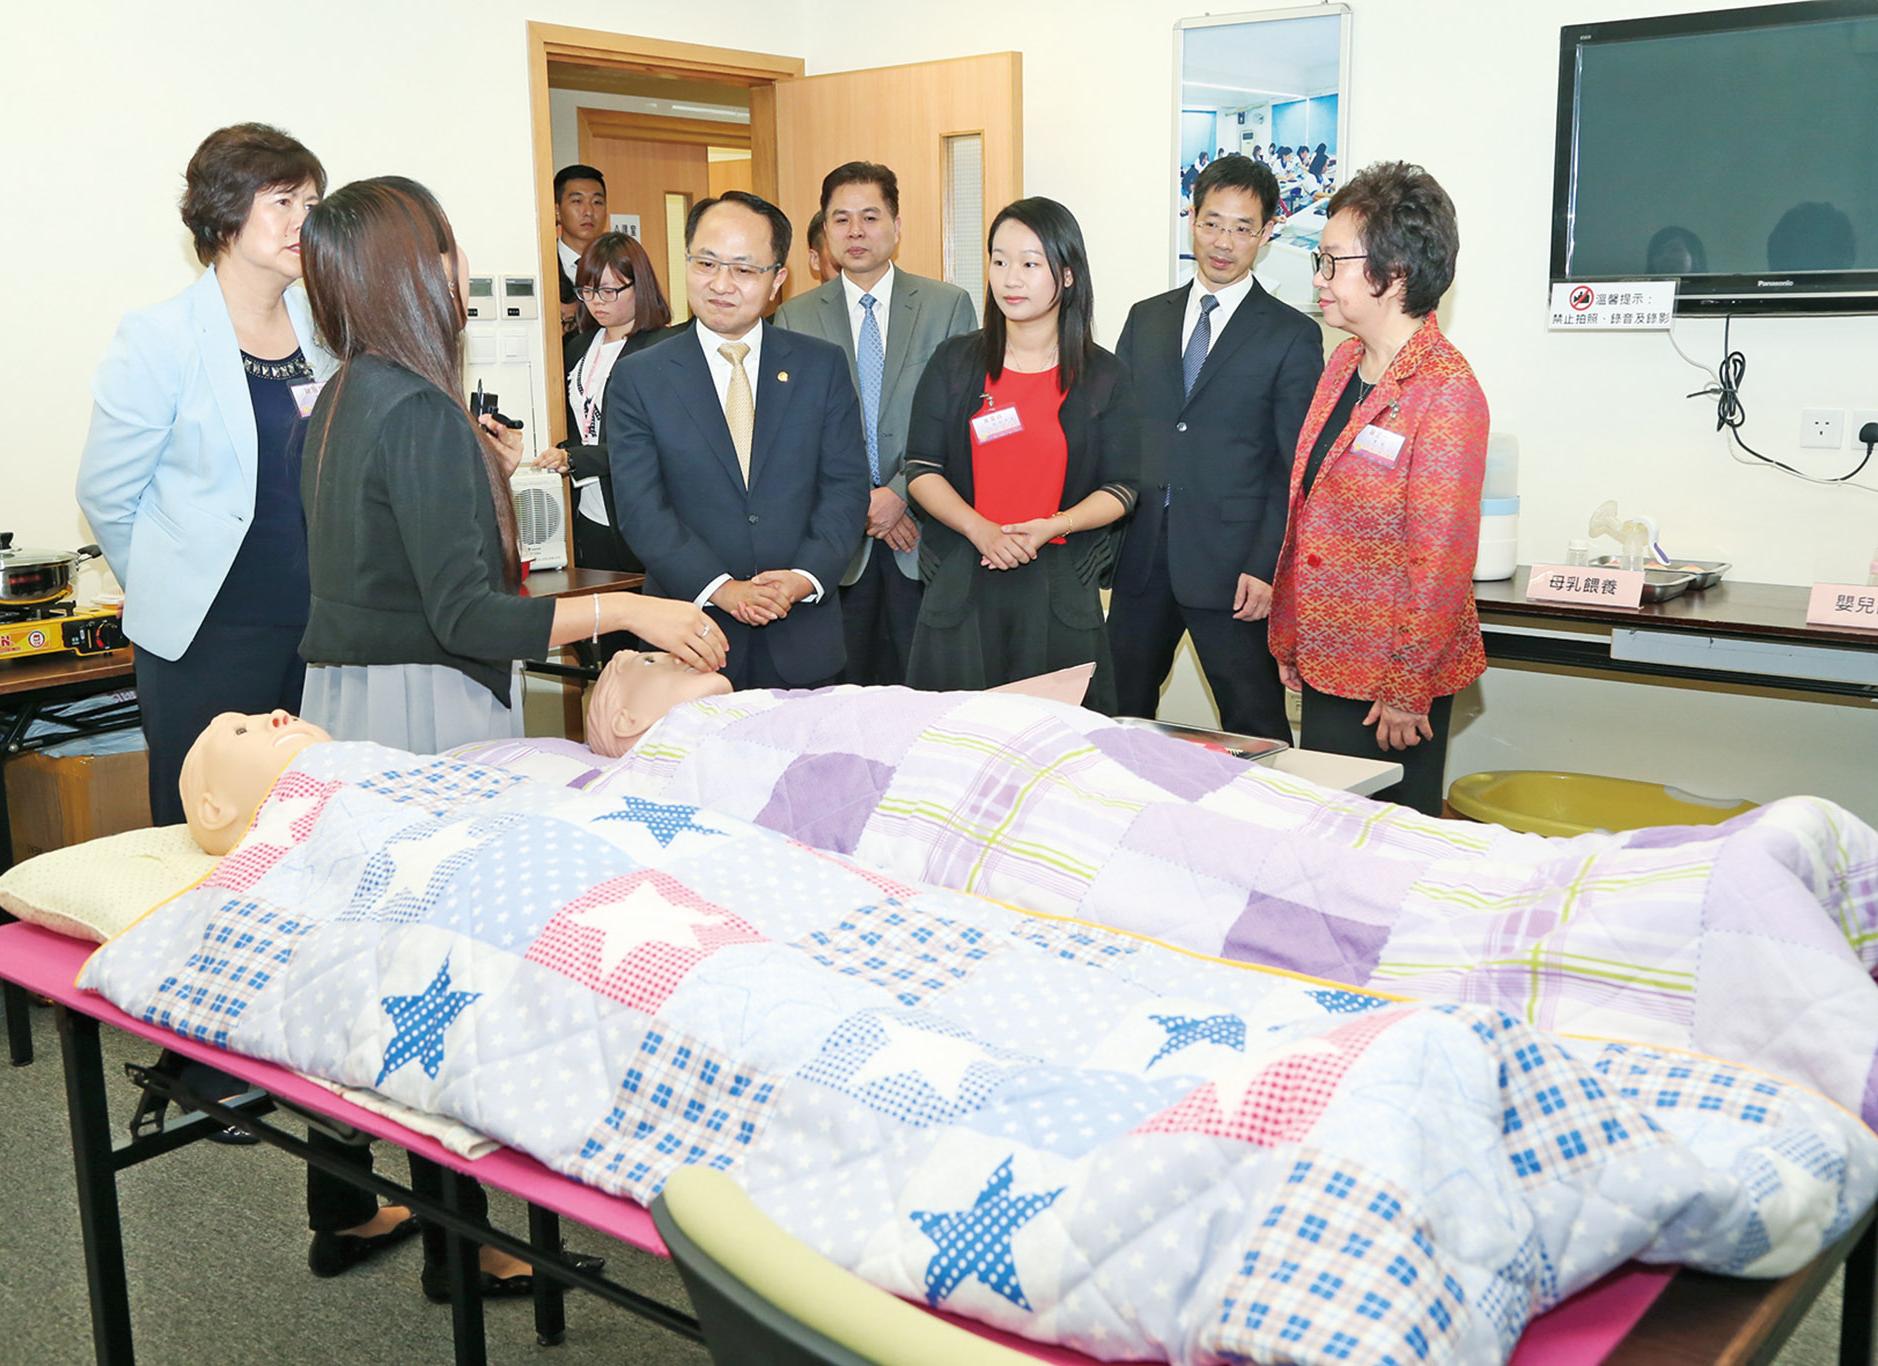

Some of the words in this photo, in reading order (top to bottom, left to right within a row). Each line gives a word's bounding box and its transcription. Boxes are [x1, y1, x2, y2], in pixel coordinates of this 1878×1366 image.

[1549, 575, 1617, 595] 母乳餵養
[1835, 594, 1878, 615] 嬰兒
